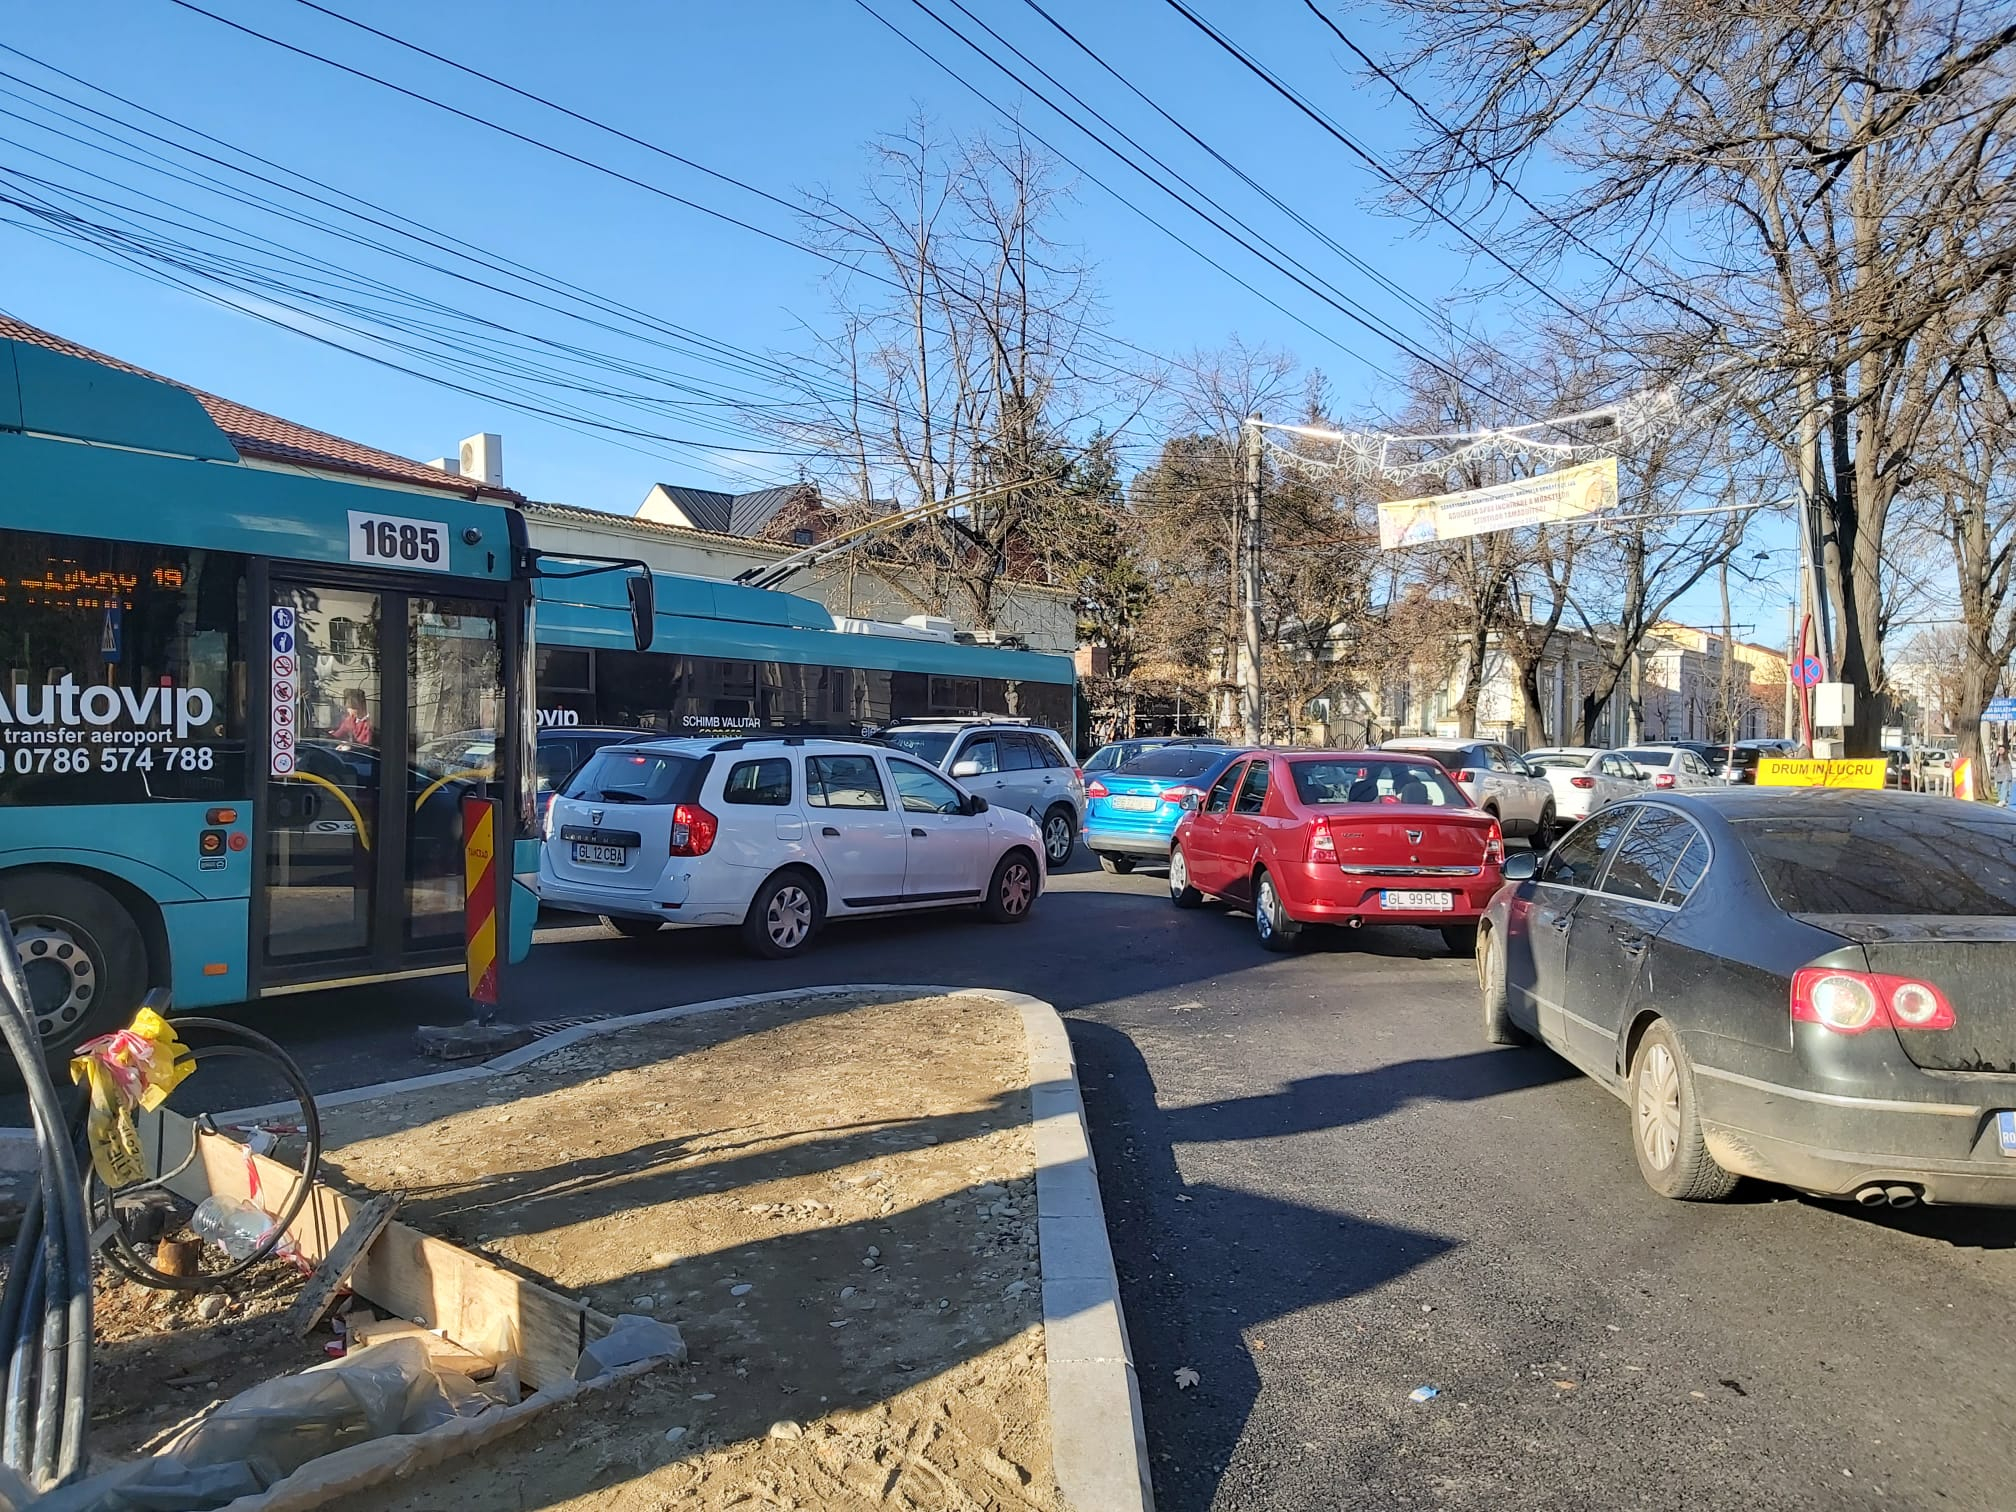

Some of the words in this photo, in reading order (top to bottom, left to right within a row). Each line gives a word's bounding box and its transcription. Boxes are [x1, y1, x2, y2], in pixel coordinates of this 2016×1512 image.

[360, 520, 440, 563] 1685
[682, 715, 720, 727] SCHIMB
[721, 717, 761, 728] VALUTAR
[4, 728, 85, 743] transfer
[91, 729, 173, 746] aeroport
[14, 747, 90, 774] 0786
[101, 747, 154, 772] 574
[163, 746, 214, 771] 788
[1772, 763, 1809, 775] DRUM
[1812, 764, 1825, 775] IN
[1829, 764, 1874, 775] LUCRU
[579, 845, 591, 859] GL
[593, 846, 602, 860] 12
[604, 848, 622, 862] CBA
[1388, 893, 1404, 905] GL
[1409, 893, 1423, 905] 99
[1425, 893, 1449, 905] RLS
[2002, 1131, 2016, 1144] RO
